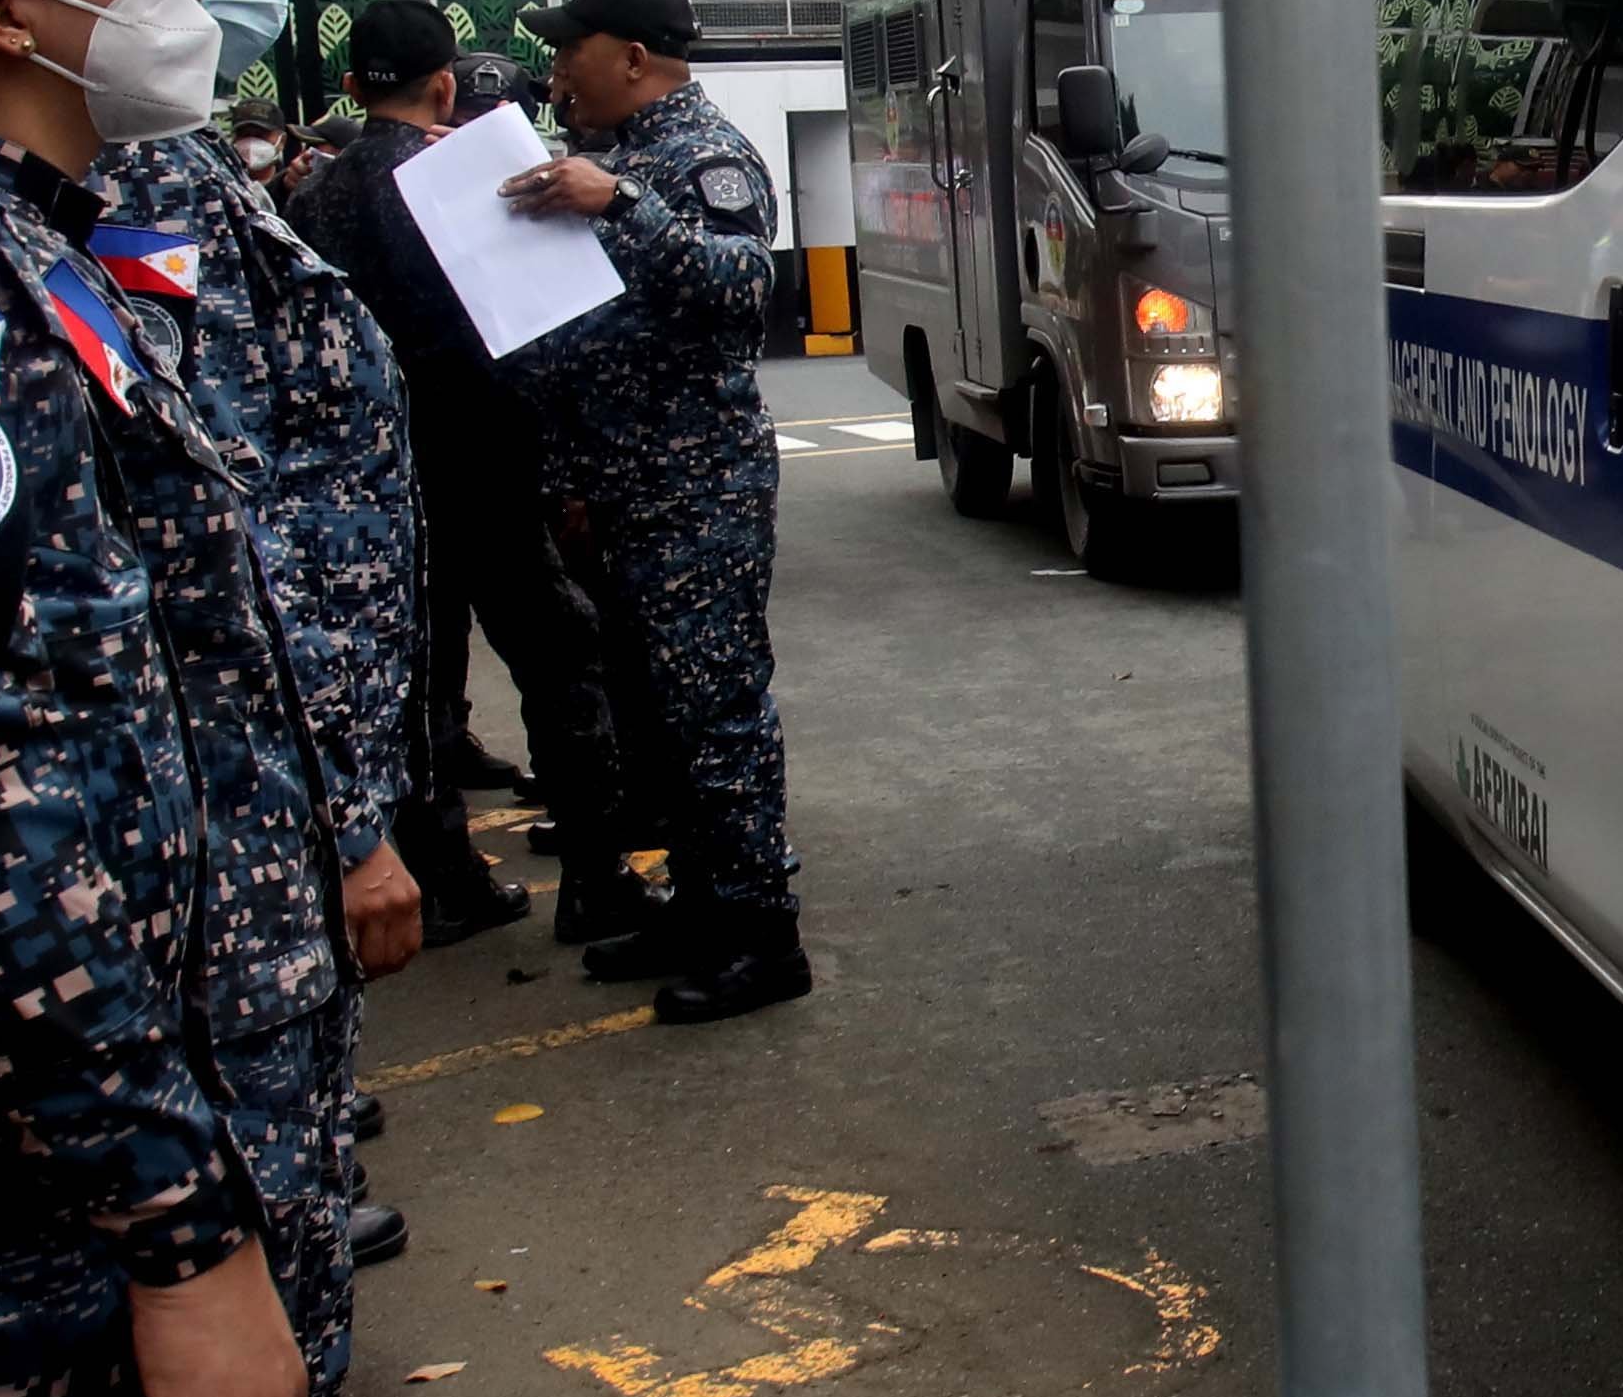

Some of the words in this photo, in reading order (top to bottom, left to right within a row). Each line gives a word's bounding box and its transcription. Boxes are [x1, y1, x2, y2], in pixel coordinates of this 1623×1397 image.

[1389, 338, 1454, 433] AGEMENT
[1457, 355, 1488, 448] AND
[1490, 363, 1588, 487] PENOLOGY
[1473, 743, 1548, 871] AFPMBAI
